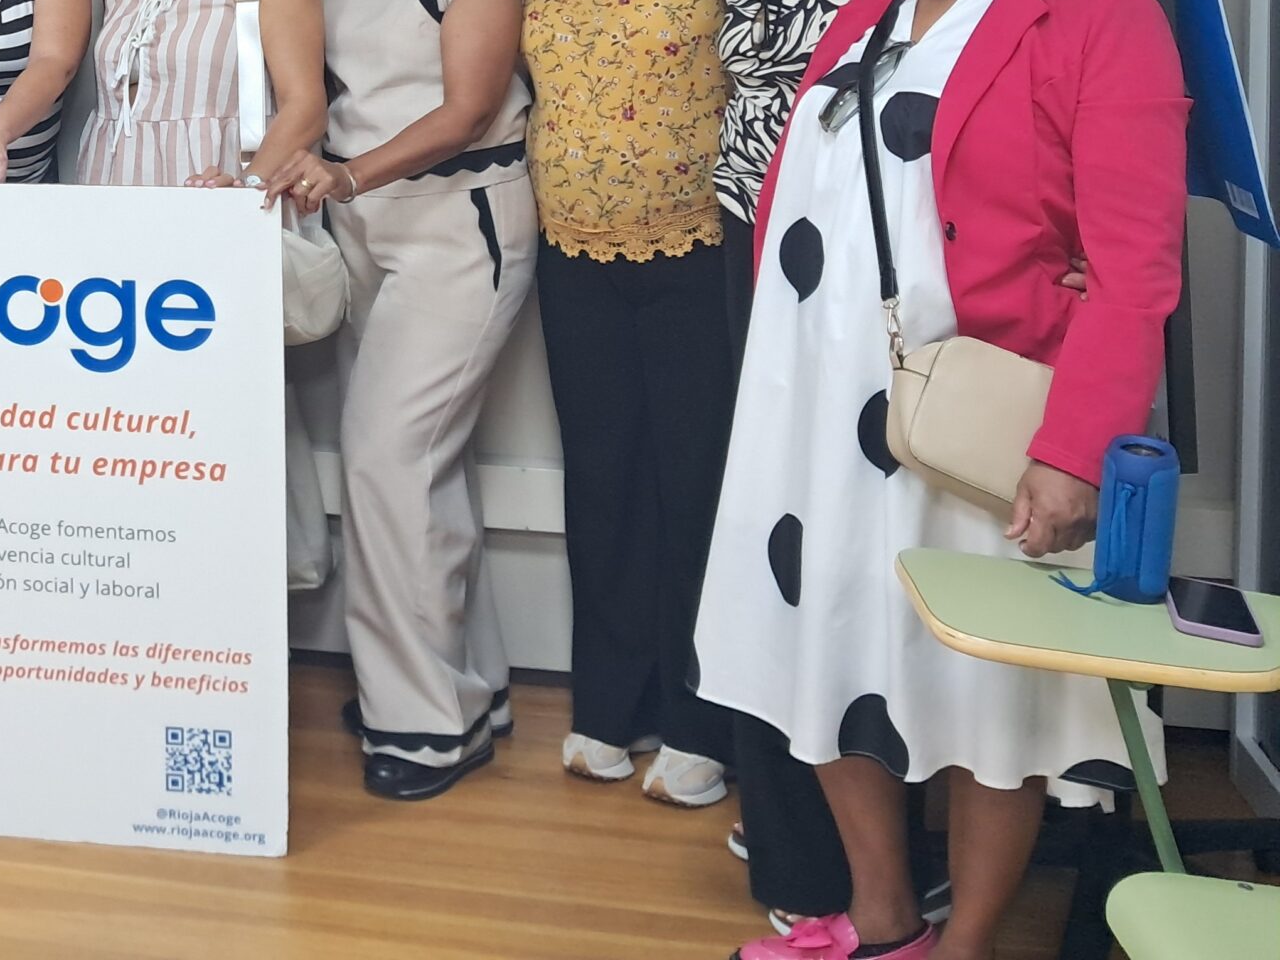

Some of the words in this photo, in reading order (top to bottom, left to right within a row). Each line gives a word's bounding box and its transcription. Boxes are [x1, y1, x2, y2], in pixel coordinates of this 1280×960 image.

[66, 406, 198, 440] cultural,
[49, 451, 81, 475] tu
[92, 456, 227, 486] empresa
[57, 520, 177, 543] fomentamos
[60, 551, 131, 569] cultural
[23, 577, 74, 594] social
[79, 582, 90, 599] y
[95, 579, 160, 599] laboral
[112, 641, 140, 658] las
[145, 642, 252, 666] diferencias
[133, 674, 146, 690] y
[150, 670, 249, 696] beneficios
[156, 807, 242, 827] @RiojaAcoge
[133, 823, 266, 845] www.riojaacoge.org
